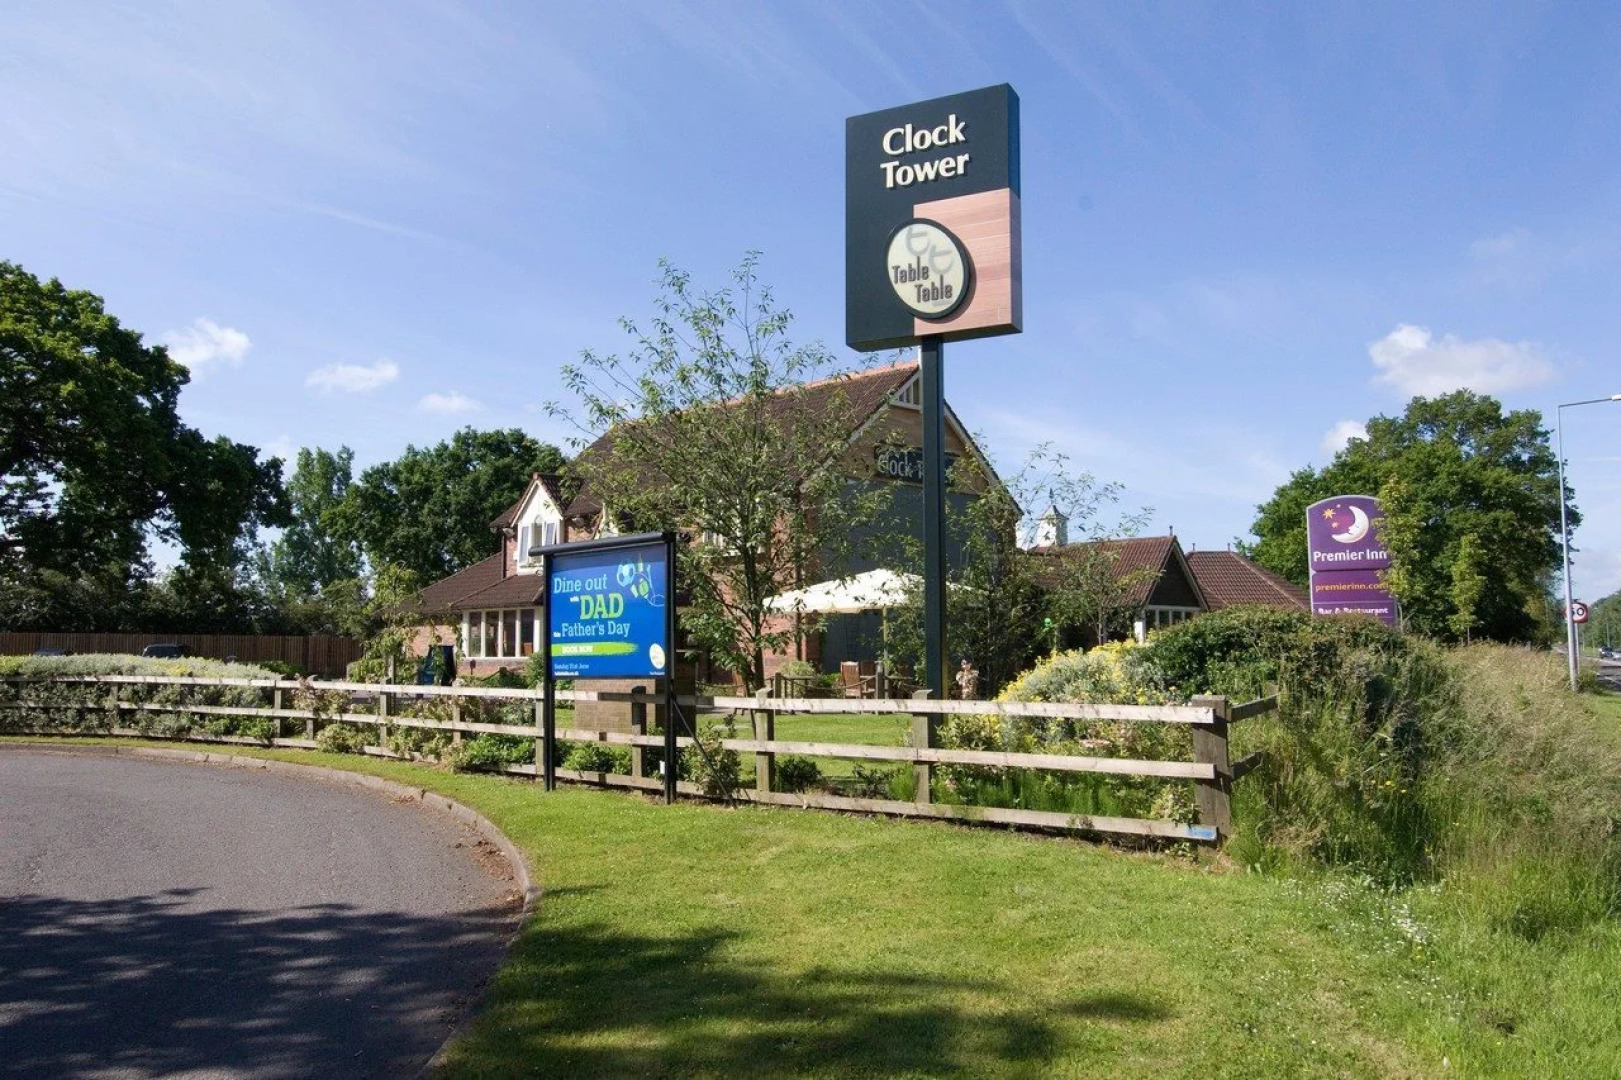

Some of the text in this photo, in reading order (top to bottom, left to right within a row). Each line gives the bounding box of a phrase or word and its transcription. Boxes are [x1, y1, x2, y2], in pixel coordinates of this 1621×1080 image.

[882, 113, 966, 155] Clock
[880, 153, 969, 188] Tower
[892, 256, 929, 285] Table
[914, 275, 953, 304] Table
[1313, 549, 1388, 562] Premier Inn
[553, 574, 607, 594] Dine out
[580, 593, 624, 620] DAD
[1318, 607, 1332, 615] Bar
[561, 621, 605, 638] Father's
[607, 620, 631, 638] Day
